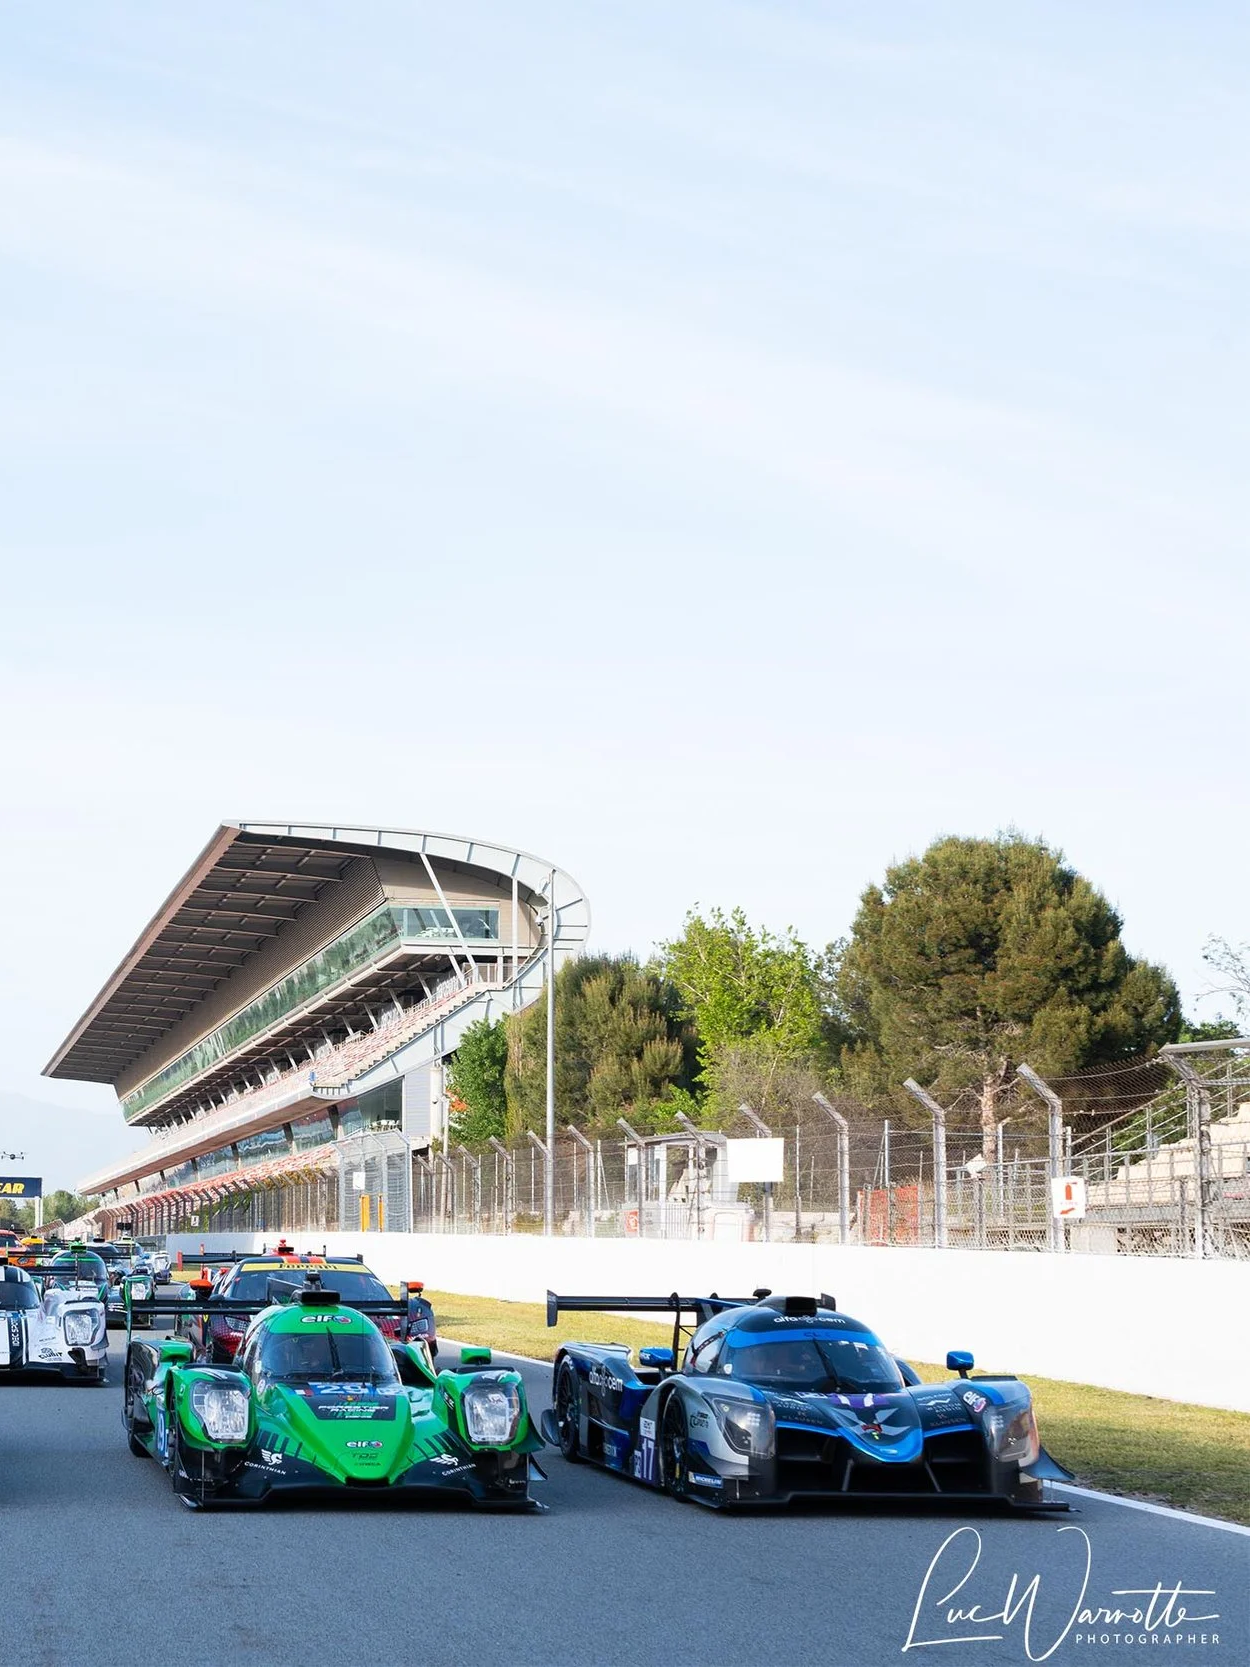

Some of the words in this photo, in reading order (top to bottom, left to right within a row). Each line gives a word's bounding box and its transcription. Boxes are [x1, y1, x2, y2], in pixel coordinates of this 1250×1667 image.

[316, 1385, 370, 1394] 29
[244, 1461, 287, 1476] CORINTHIAN
[441, 1463, 477, 1476] CORINTHIAN
